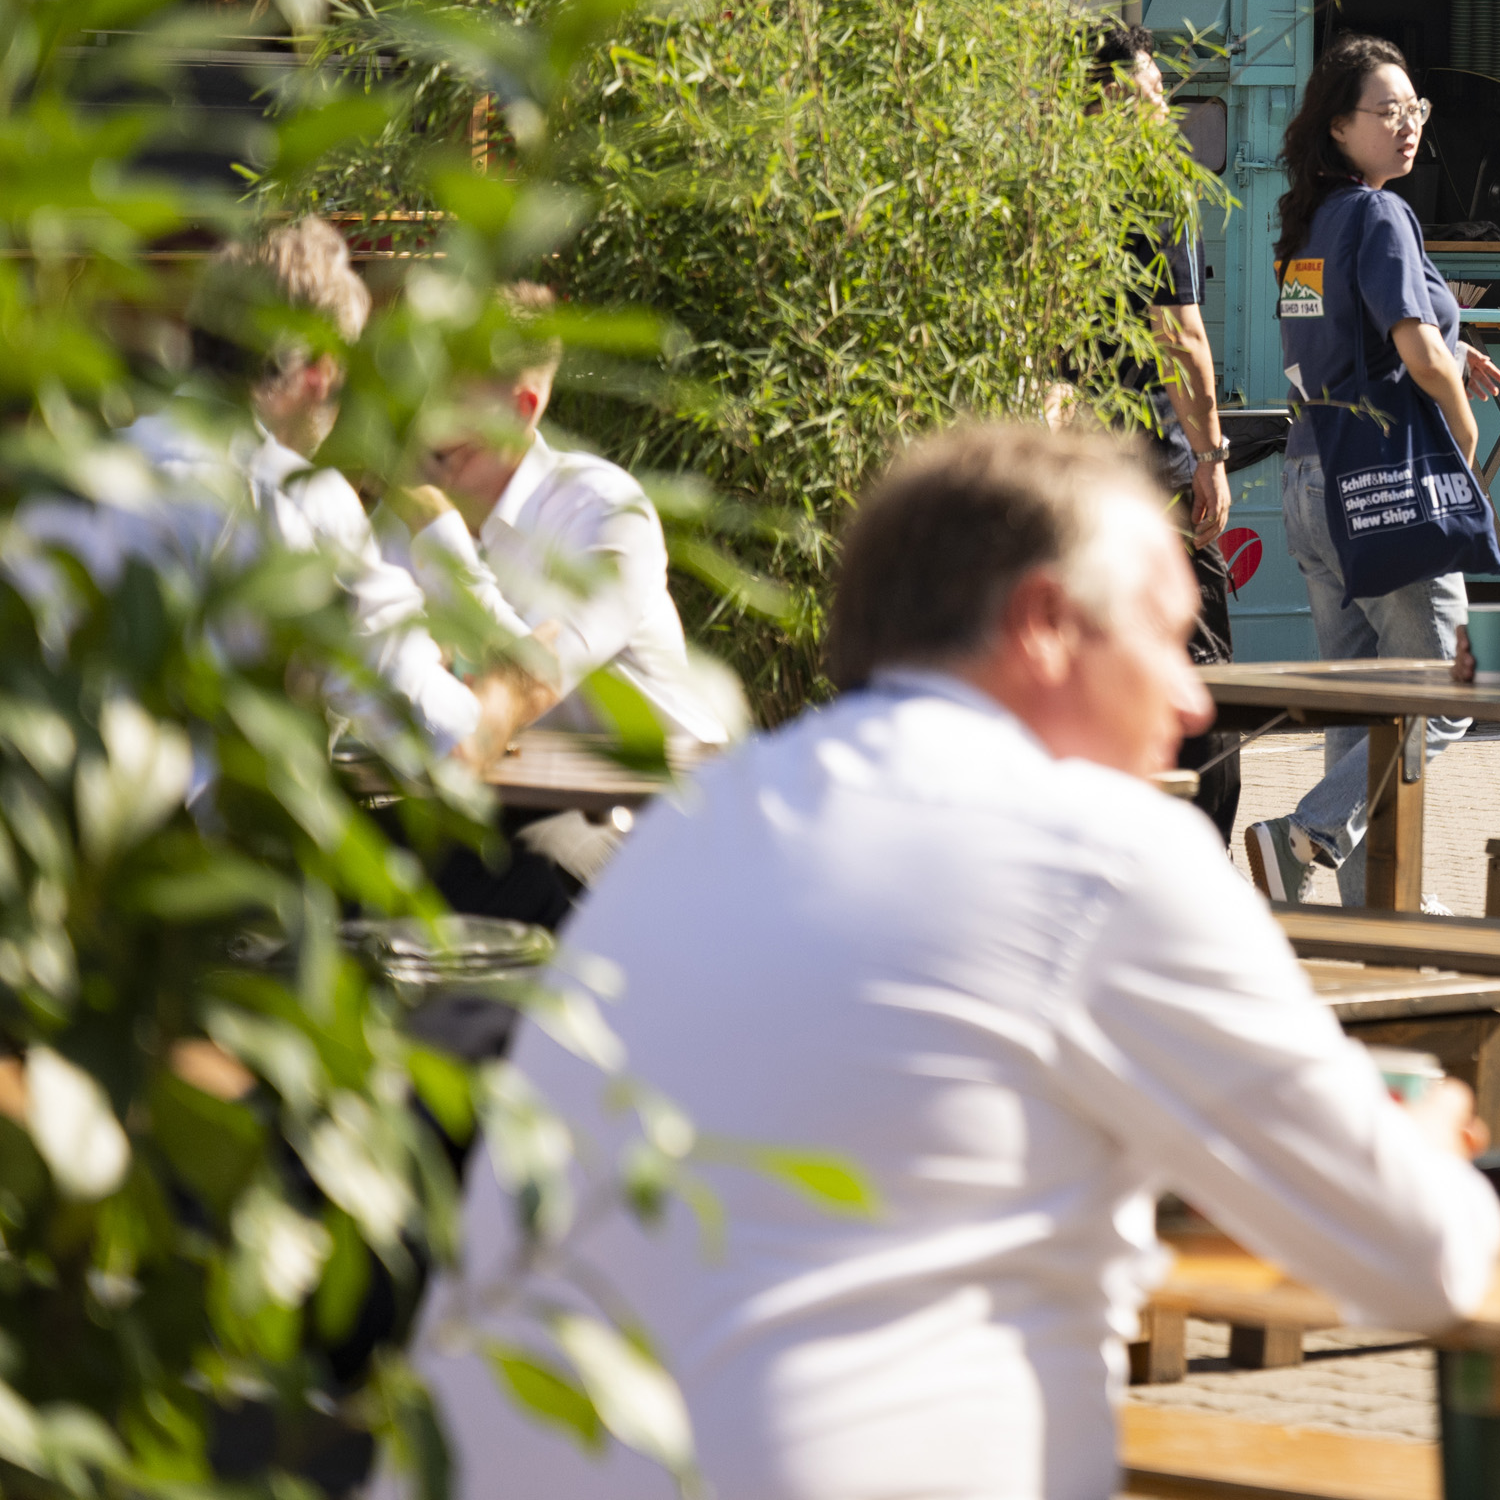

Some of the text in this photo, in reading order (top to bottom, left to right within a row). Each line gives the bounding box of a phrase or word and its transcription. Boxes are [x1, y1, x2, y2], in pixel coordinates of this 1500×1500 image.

[1341, 468, 1412, 494] Schiff&Hafen
[1420, 472, 1473, 509] THB
[1352, 513, 1381, 531] New
[1382, 508, 1417, 525] Ships
